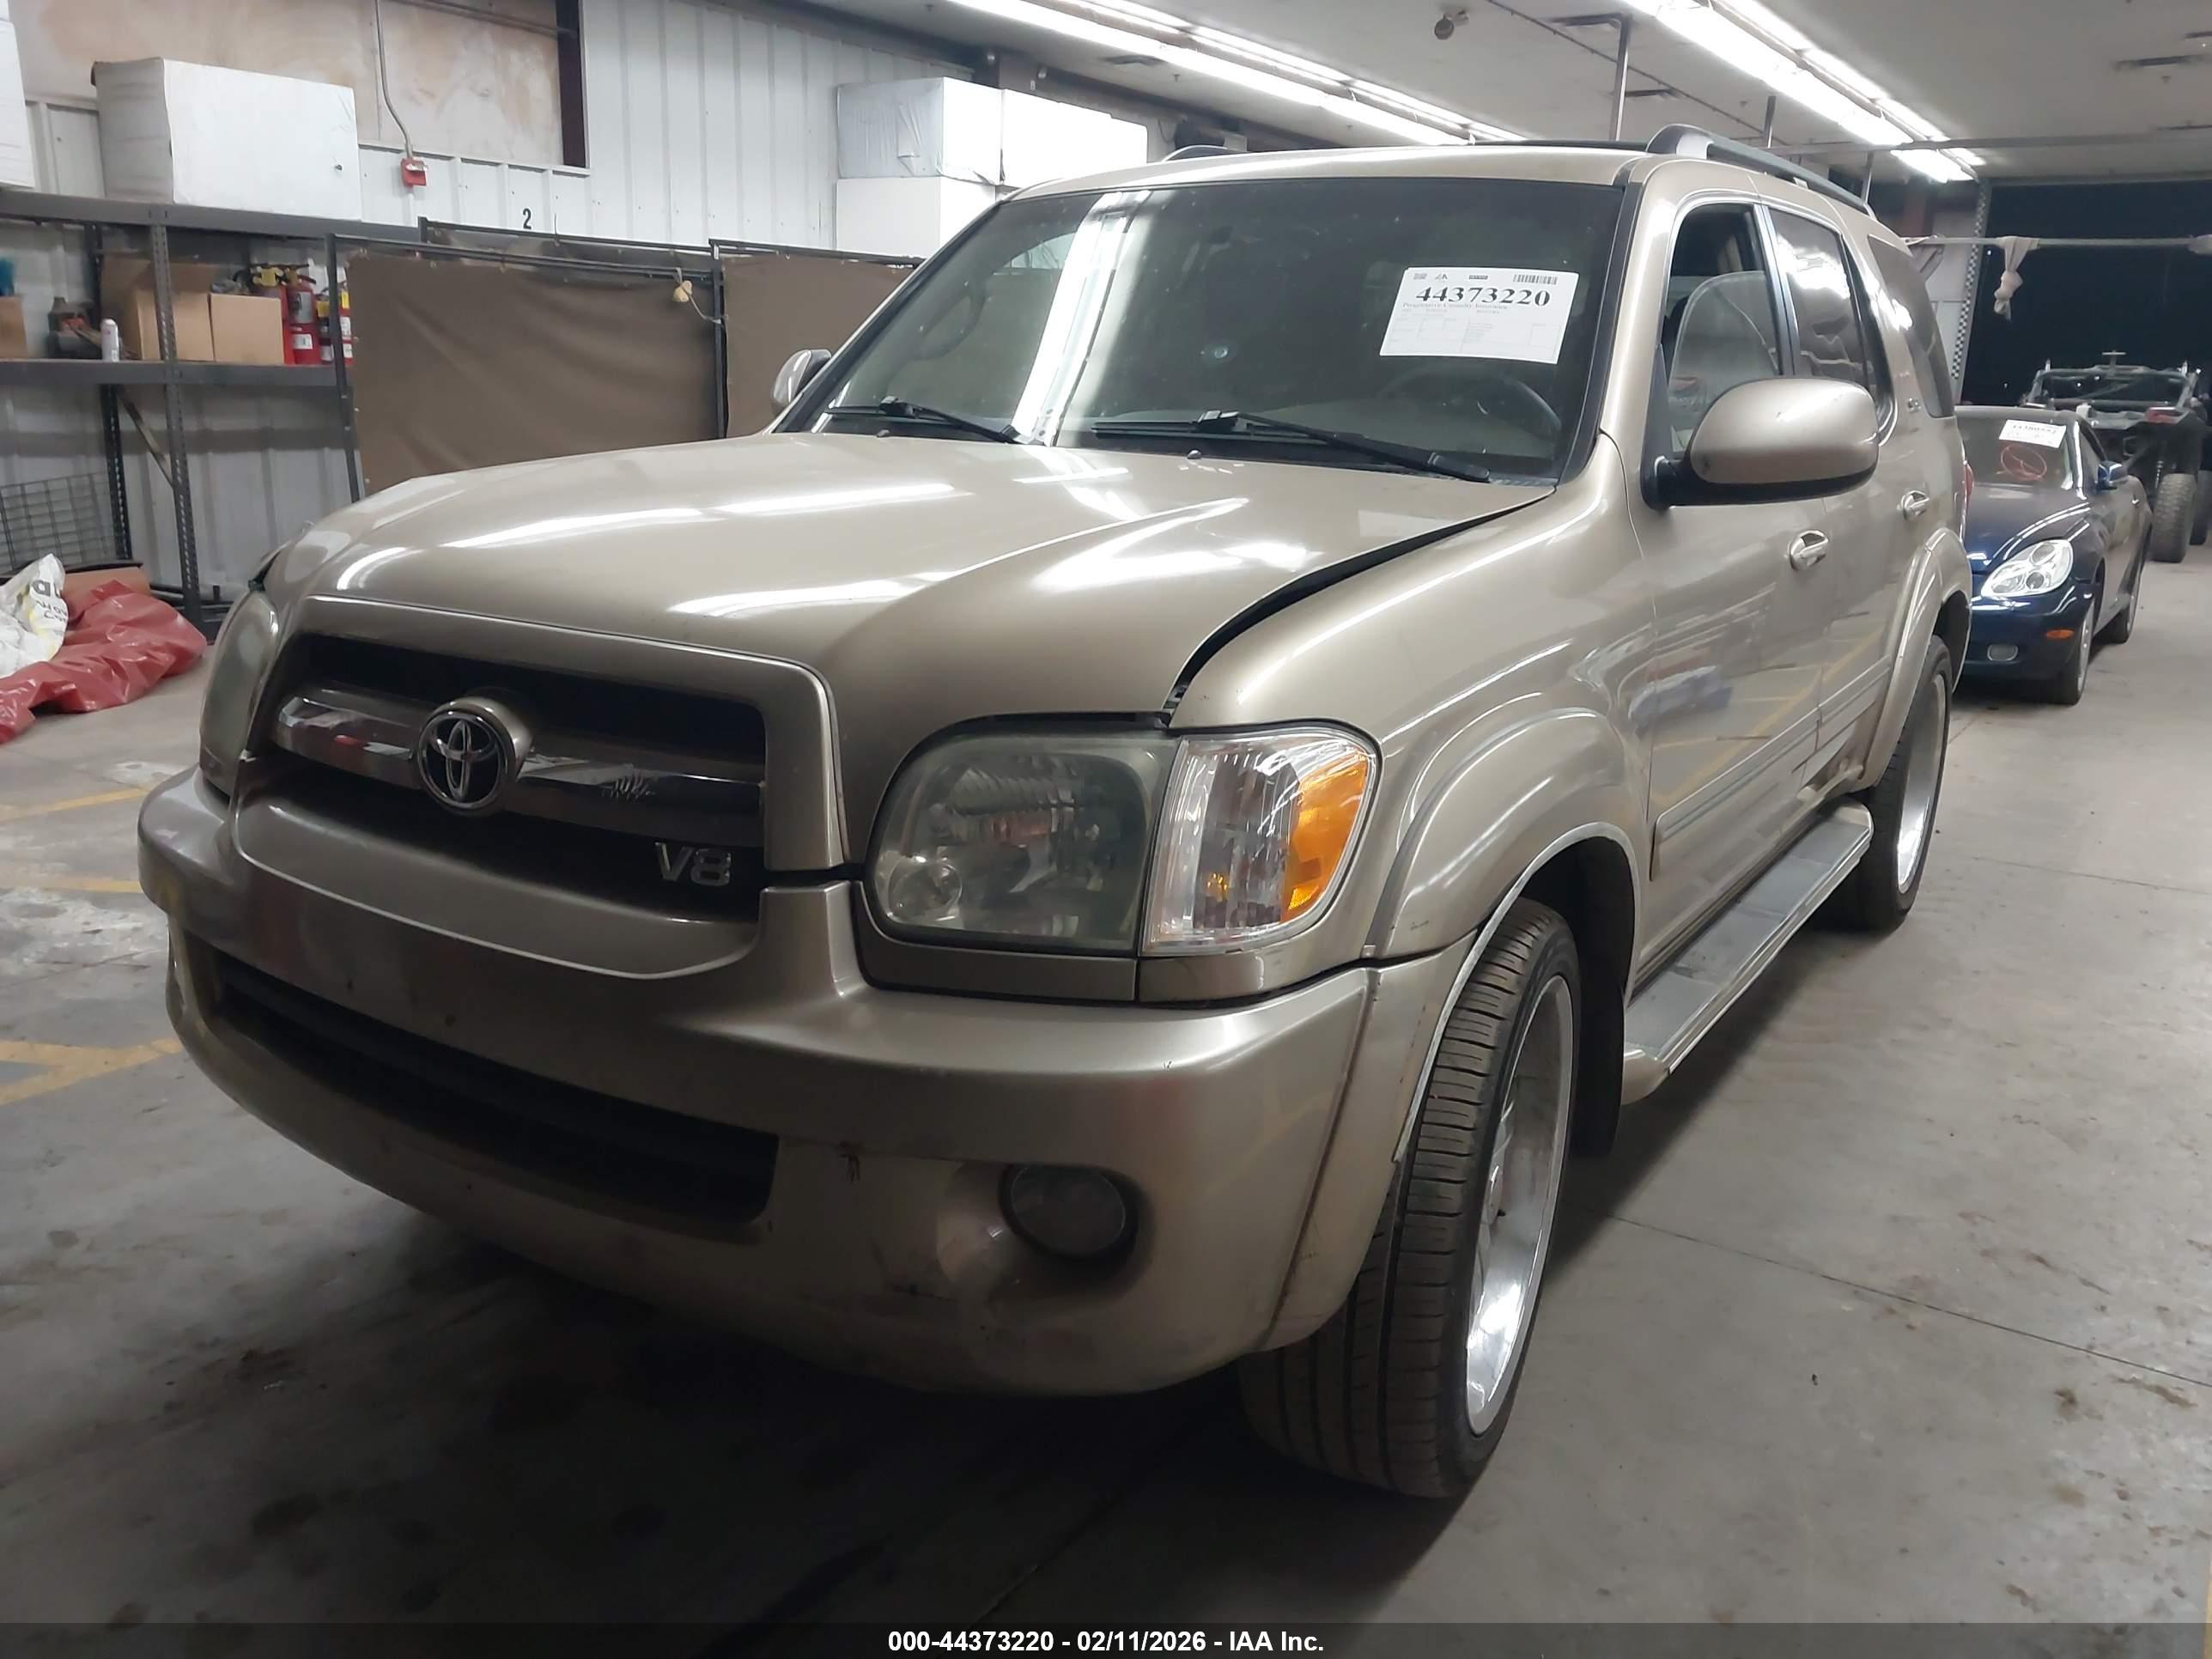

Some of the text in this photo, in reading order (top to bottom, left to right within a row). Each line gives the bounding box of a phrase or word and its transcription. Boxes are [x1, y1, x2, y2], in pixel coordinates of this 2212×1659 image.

[522, 208, 532, 230] 2
[1415, 286, 1551, 307] 44373220
[654, 842, 732, 887] V8
